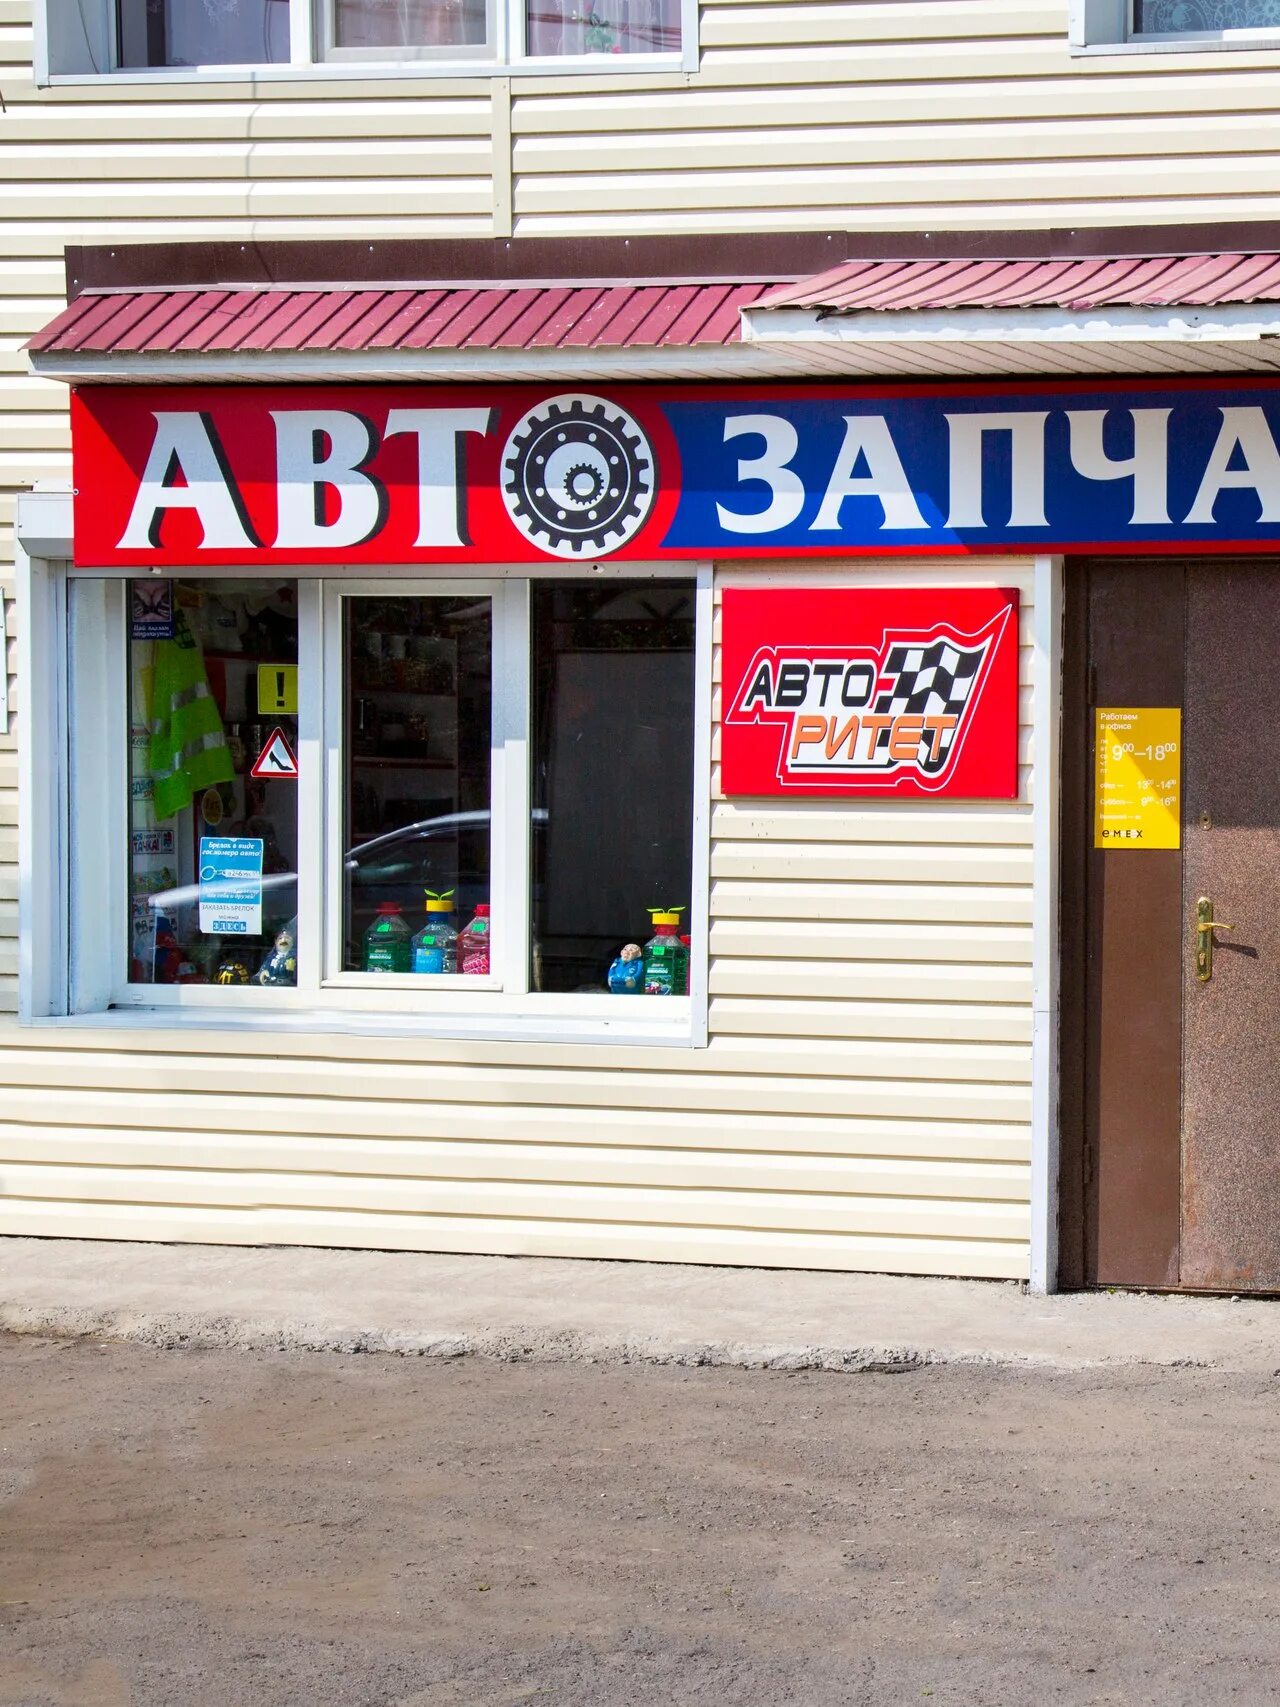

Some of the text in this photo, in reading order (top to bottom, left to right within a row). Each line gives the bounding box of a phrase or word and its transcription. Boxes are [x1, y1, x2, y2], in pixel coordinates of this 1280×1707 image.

[744, 663, 875, 708] АВТО
[790, 715, 957, 761] РИТЕТ
[213, 920, 247, 932] ЗДЕСЬ
